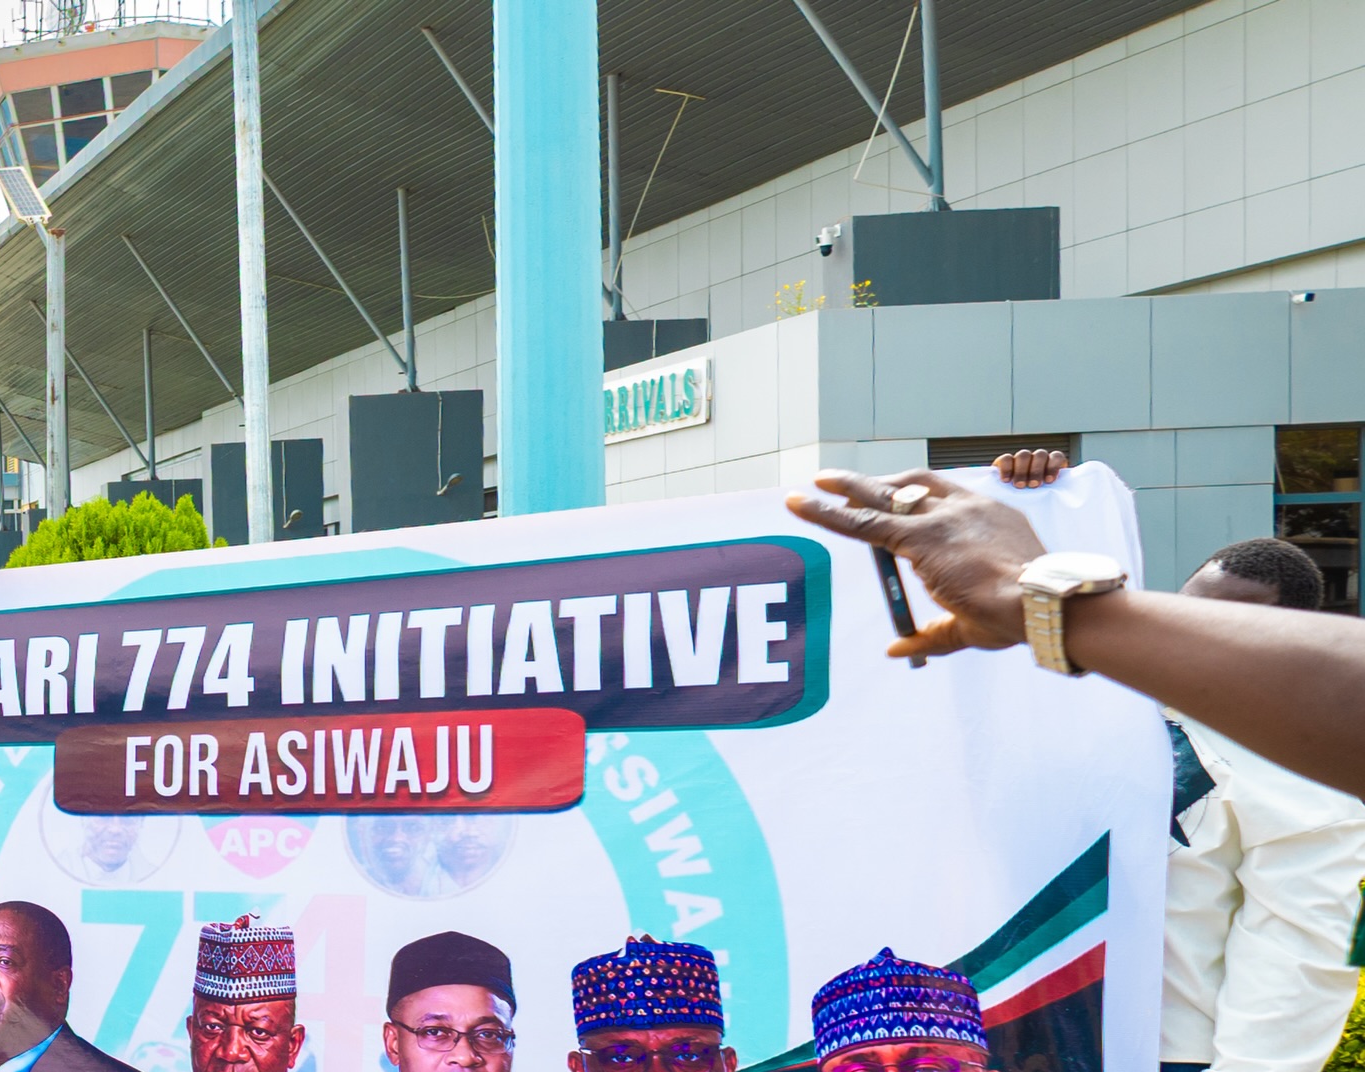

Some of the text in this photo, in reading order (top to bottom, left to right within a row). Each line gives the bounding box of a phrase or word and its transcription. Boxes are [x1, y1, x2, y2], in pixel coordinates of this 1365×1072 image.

[603, 368, 701, 435] RRIVALS
[122, 620, 255, 713] 774
[281, 581, 789, 707] INITIATIVE
[125, 724, 494, 797] FOR ASIWAJU
[219, 828, 303, 858] APC
